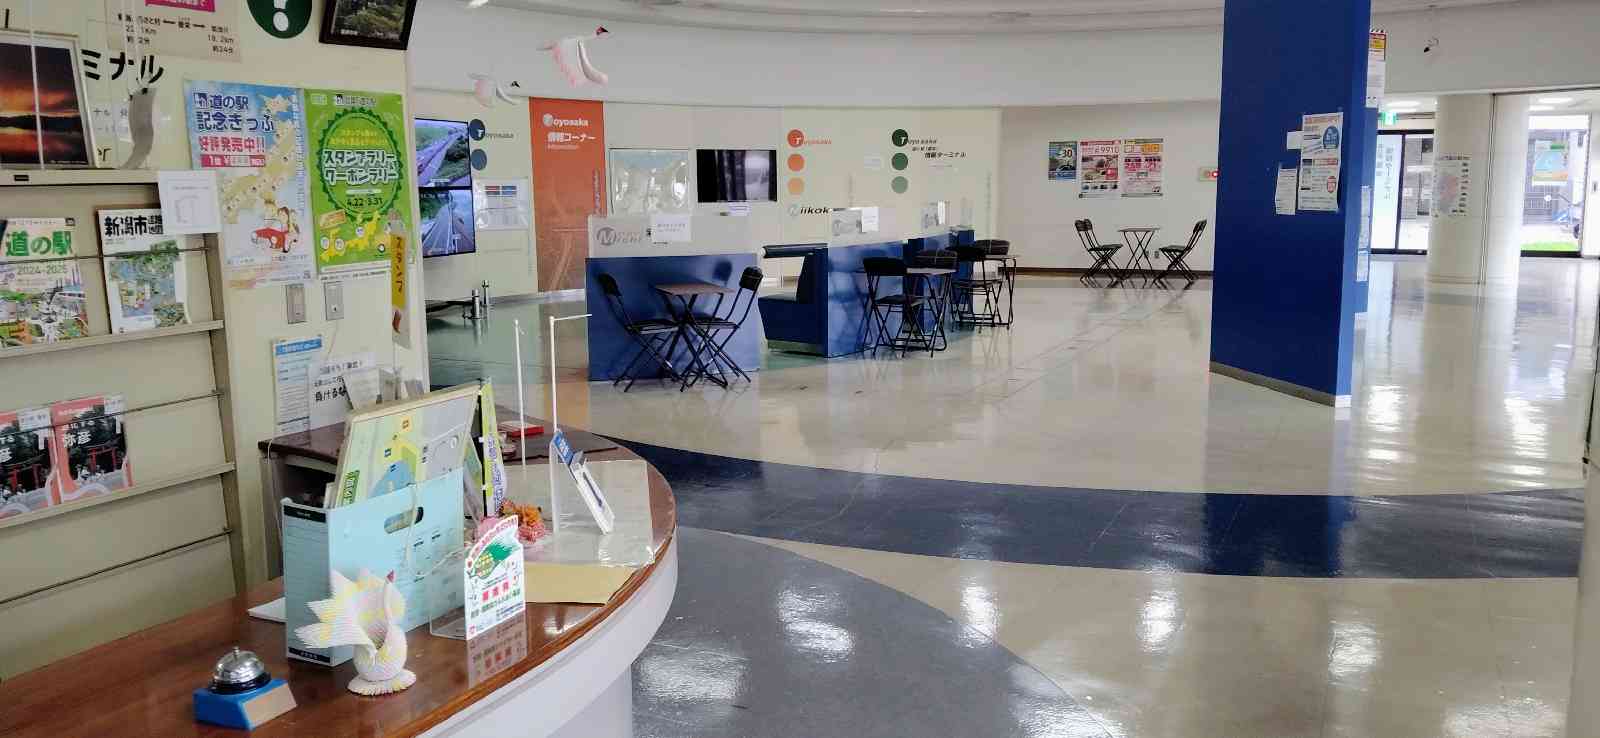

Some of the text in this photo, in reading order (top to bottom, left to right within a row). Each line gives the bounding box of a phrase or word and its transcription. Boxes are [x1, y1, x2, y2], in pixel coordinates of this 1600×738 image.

[209, 94, 249, 110] 道の駅
[196, 111, 274, 132] 記念きっぷ
[104, 215, 147, 238] 新潟市
[5, 230, 73, 257] 道の駅
